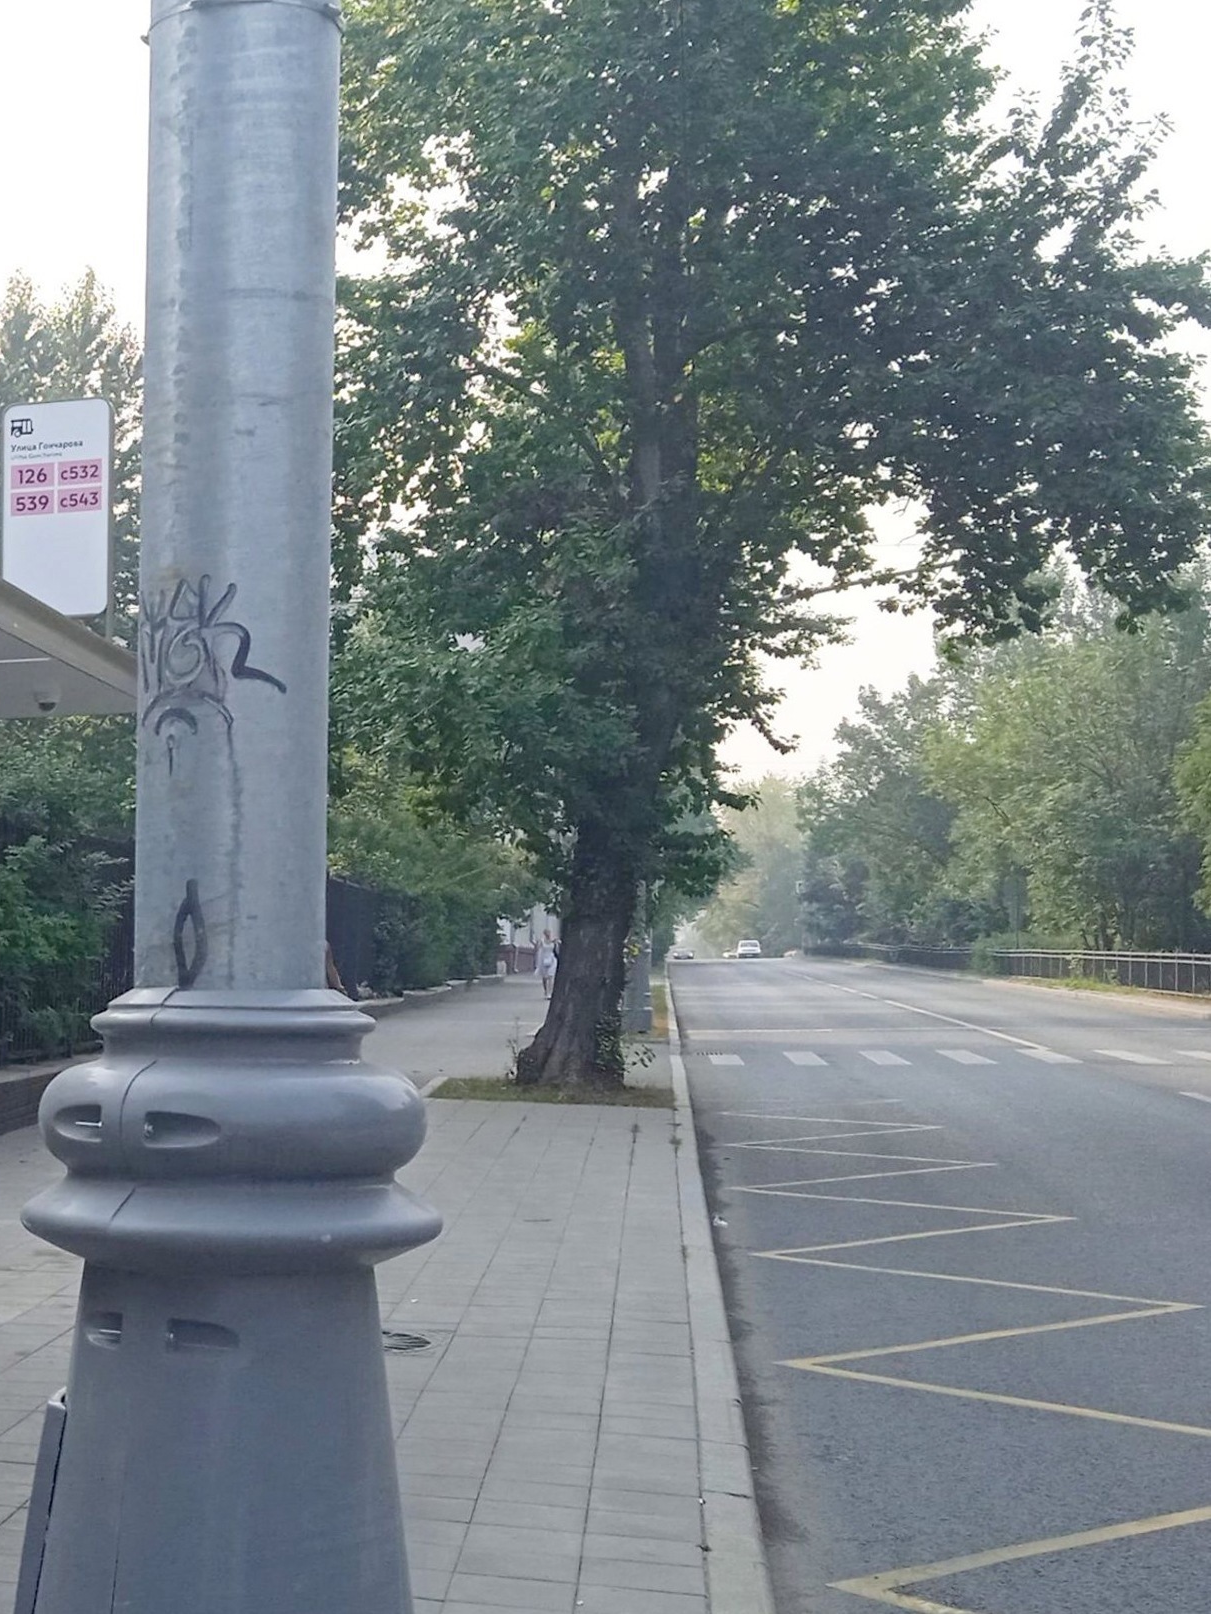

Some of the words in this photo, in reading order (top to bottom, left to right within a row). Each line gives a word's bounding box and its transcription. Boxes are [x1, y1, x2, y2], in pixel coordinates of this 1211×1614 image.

[11, 444, 37, 452] Улица
[17, 467, 47, 484] 126
[60, 464, 99, 480] с532
[16, 495, 49, 512] 539
[60, 492, 99, 508] с543
